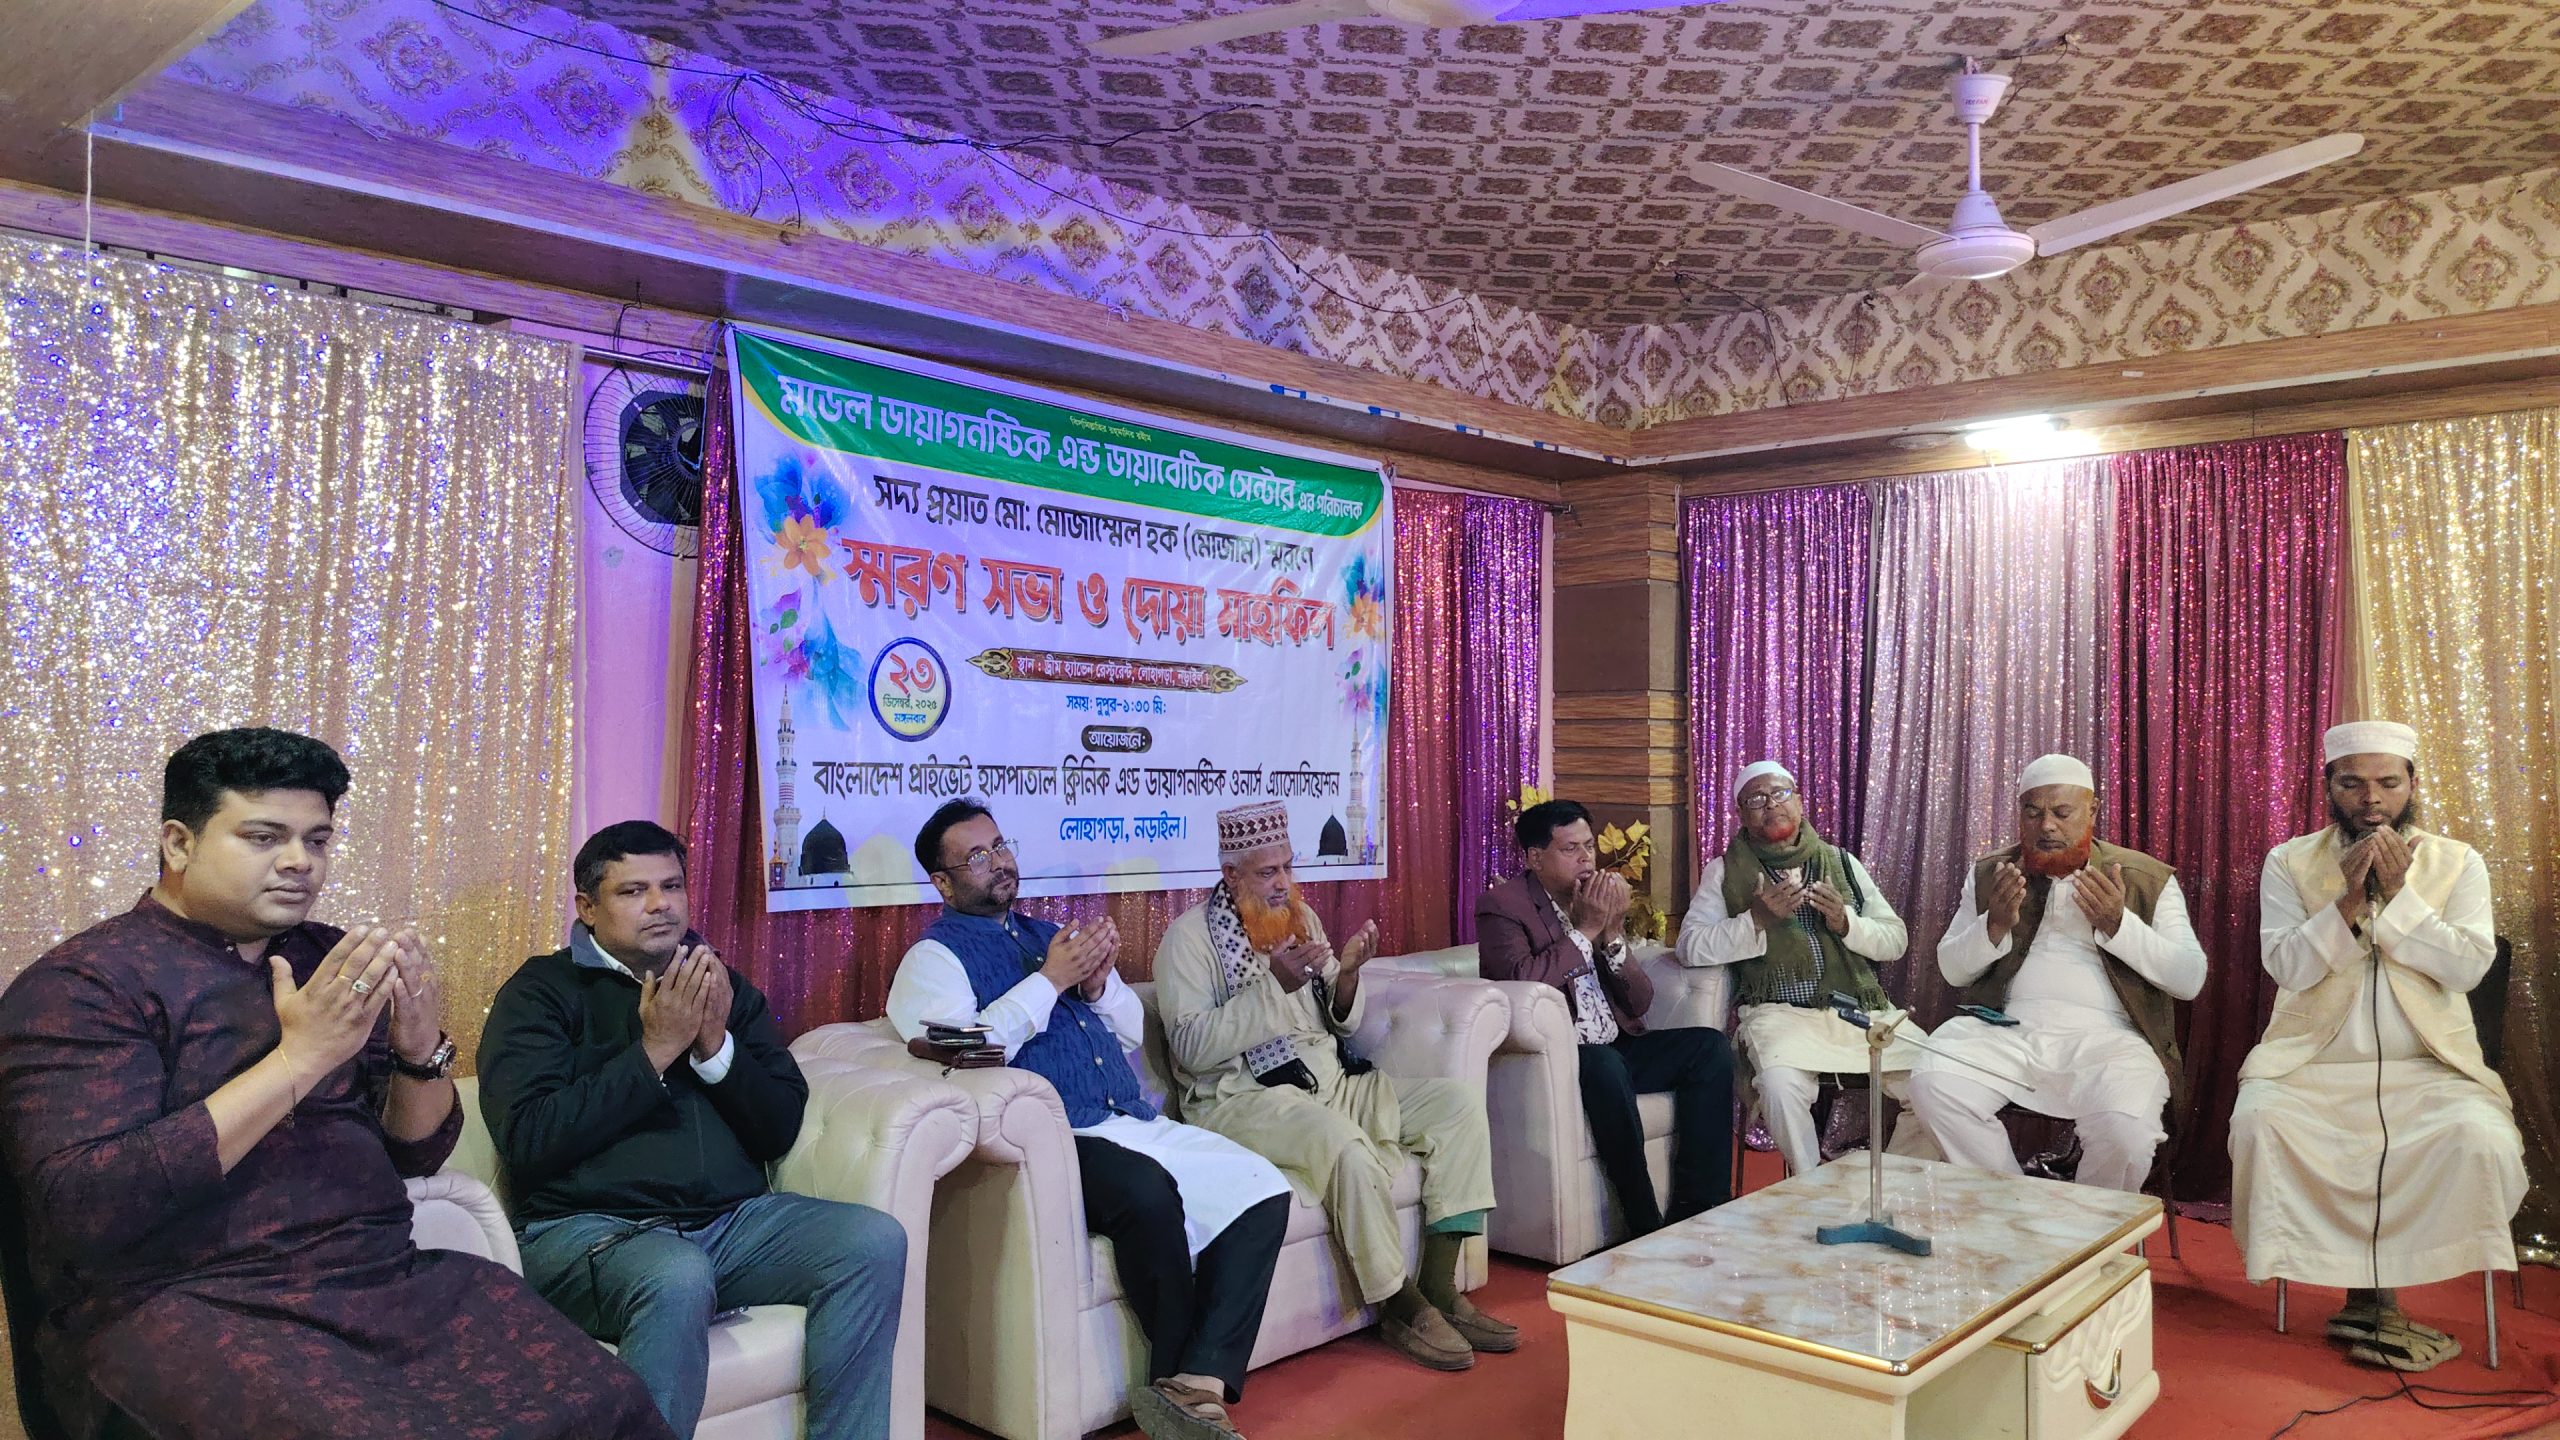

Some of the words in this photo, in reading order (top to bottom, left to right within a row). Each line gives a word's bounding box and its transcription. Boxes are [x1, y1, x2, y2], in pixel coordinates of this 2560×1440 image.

[778, 374, 872, 430] মডেল
[1057, 435, 1100, 475] এন্ড
[1104, 443, 1225, 496] ডায়াবেটিক
[1229, 466, 1296, 512] সেন্টার
[1298, 492, 1315, 513] এর
[1316, 488, 1363, 520] পরিচালক
[873, 475, 921, 515] সদ্য
[926, 485, 990, 526] প্রয়াত
[1037, 504, 1142, 549] মোজাম্মেল
[1145, 522, 1179, 555] হক
[1264, 539, 1314, 573] স্মরণে
[841, 538, 968, 619] স্মরণ
[980, 557, 1064, 624] সভা
[1077, 571, 1109, 628] ও
[1121, 577, 1207, 645] দোয়া
[1216, 576, 1338, 650] মাহফিল
[889, 653, 936, 697] ২৩
[813, 760, 904, 800] বাংলাদেশ
[908, 753, 972, 799] প্রাইভেট
[977, 764, 1057, 796] হাসপাতাল
[1062, 754, 1111, 806] ক্লিনিক
[1229, 762, 1262, 796] ওনার্স
[1059, 817, 1130, 844] লোহাগড়া,
[1133, 810, 1187, 843] নড়াইল।
